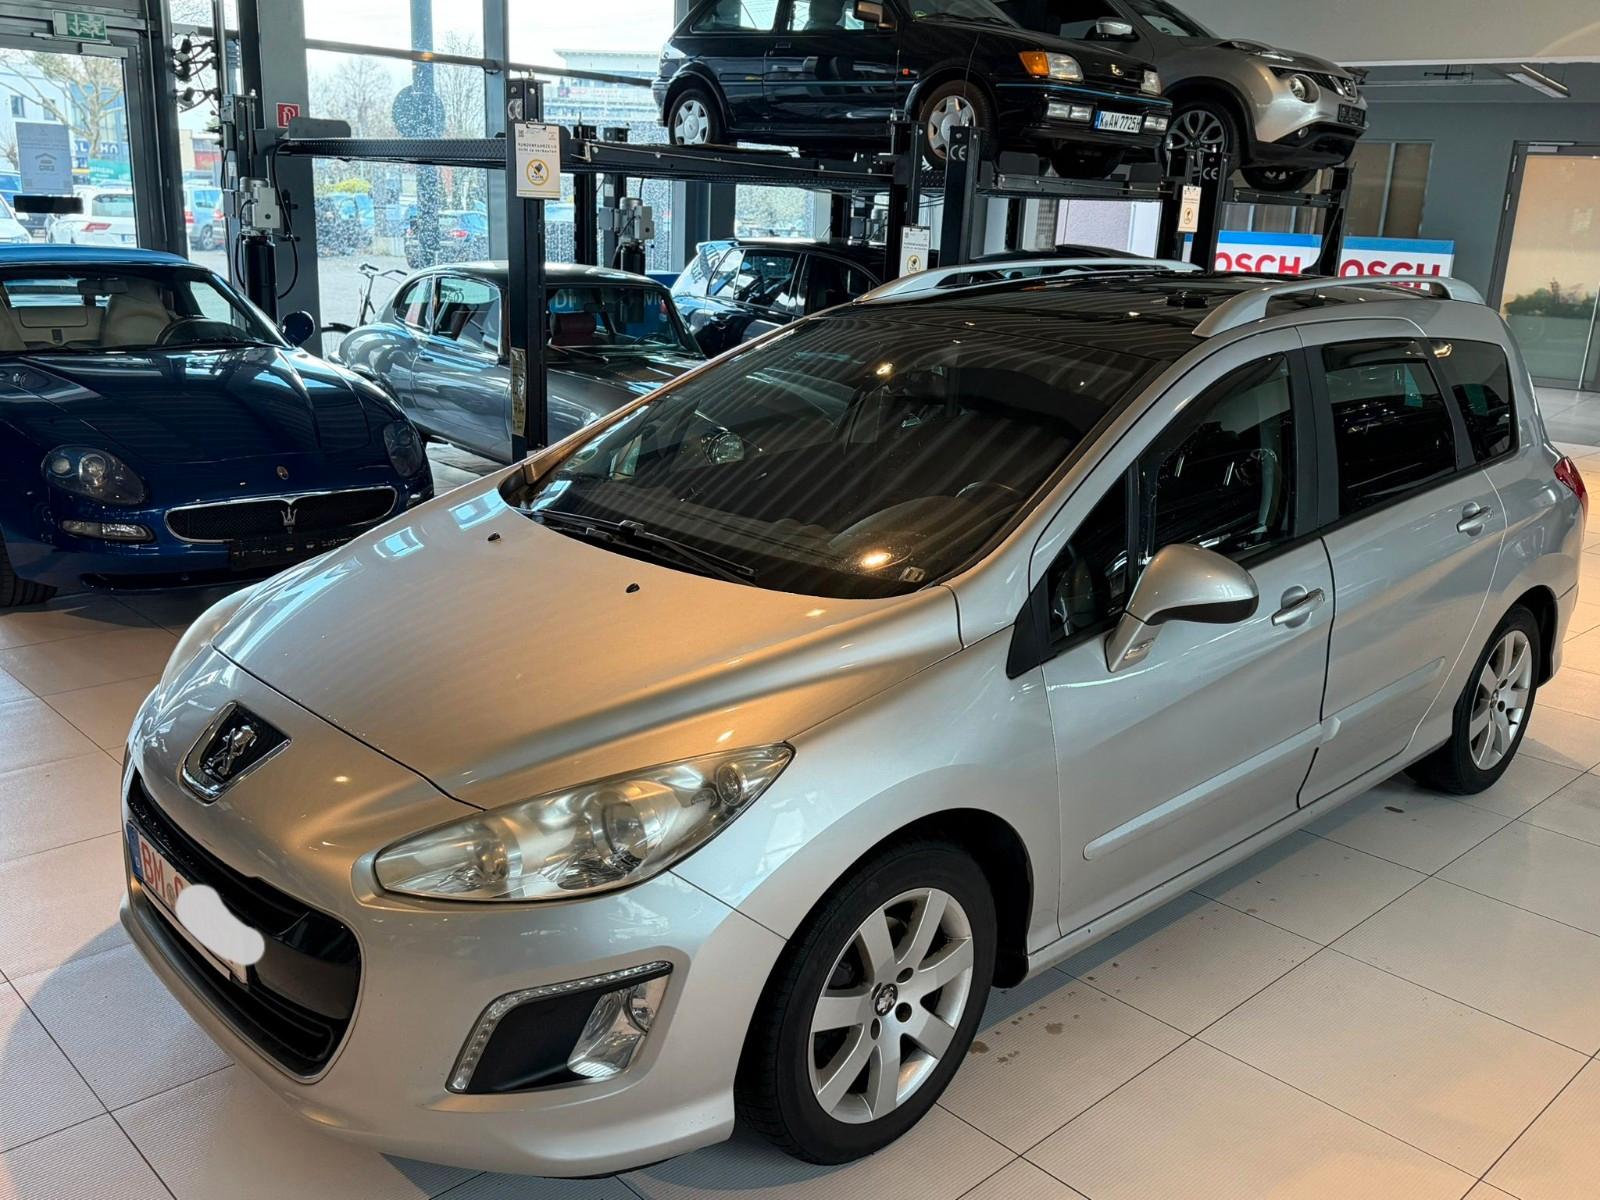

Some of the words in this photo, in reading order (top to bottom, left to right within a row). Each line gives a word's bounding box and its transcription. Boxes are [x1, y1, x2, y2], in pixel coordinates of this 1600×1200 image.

[1120, 116, 1140, 131] 7725H
[950, 144, 967, 161] CE
[1202, 167, 1219, 180] CE
[1214, 252, 1301, 274] OSCH
[1340, 259, 1440, 288] OSCH
[141, 841, 166, 898] BM
